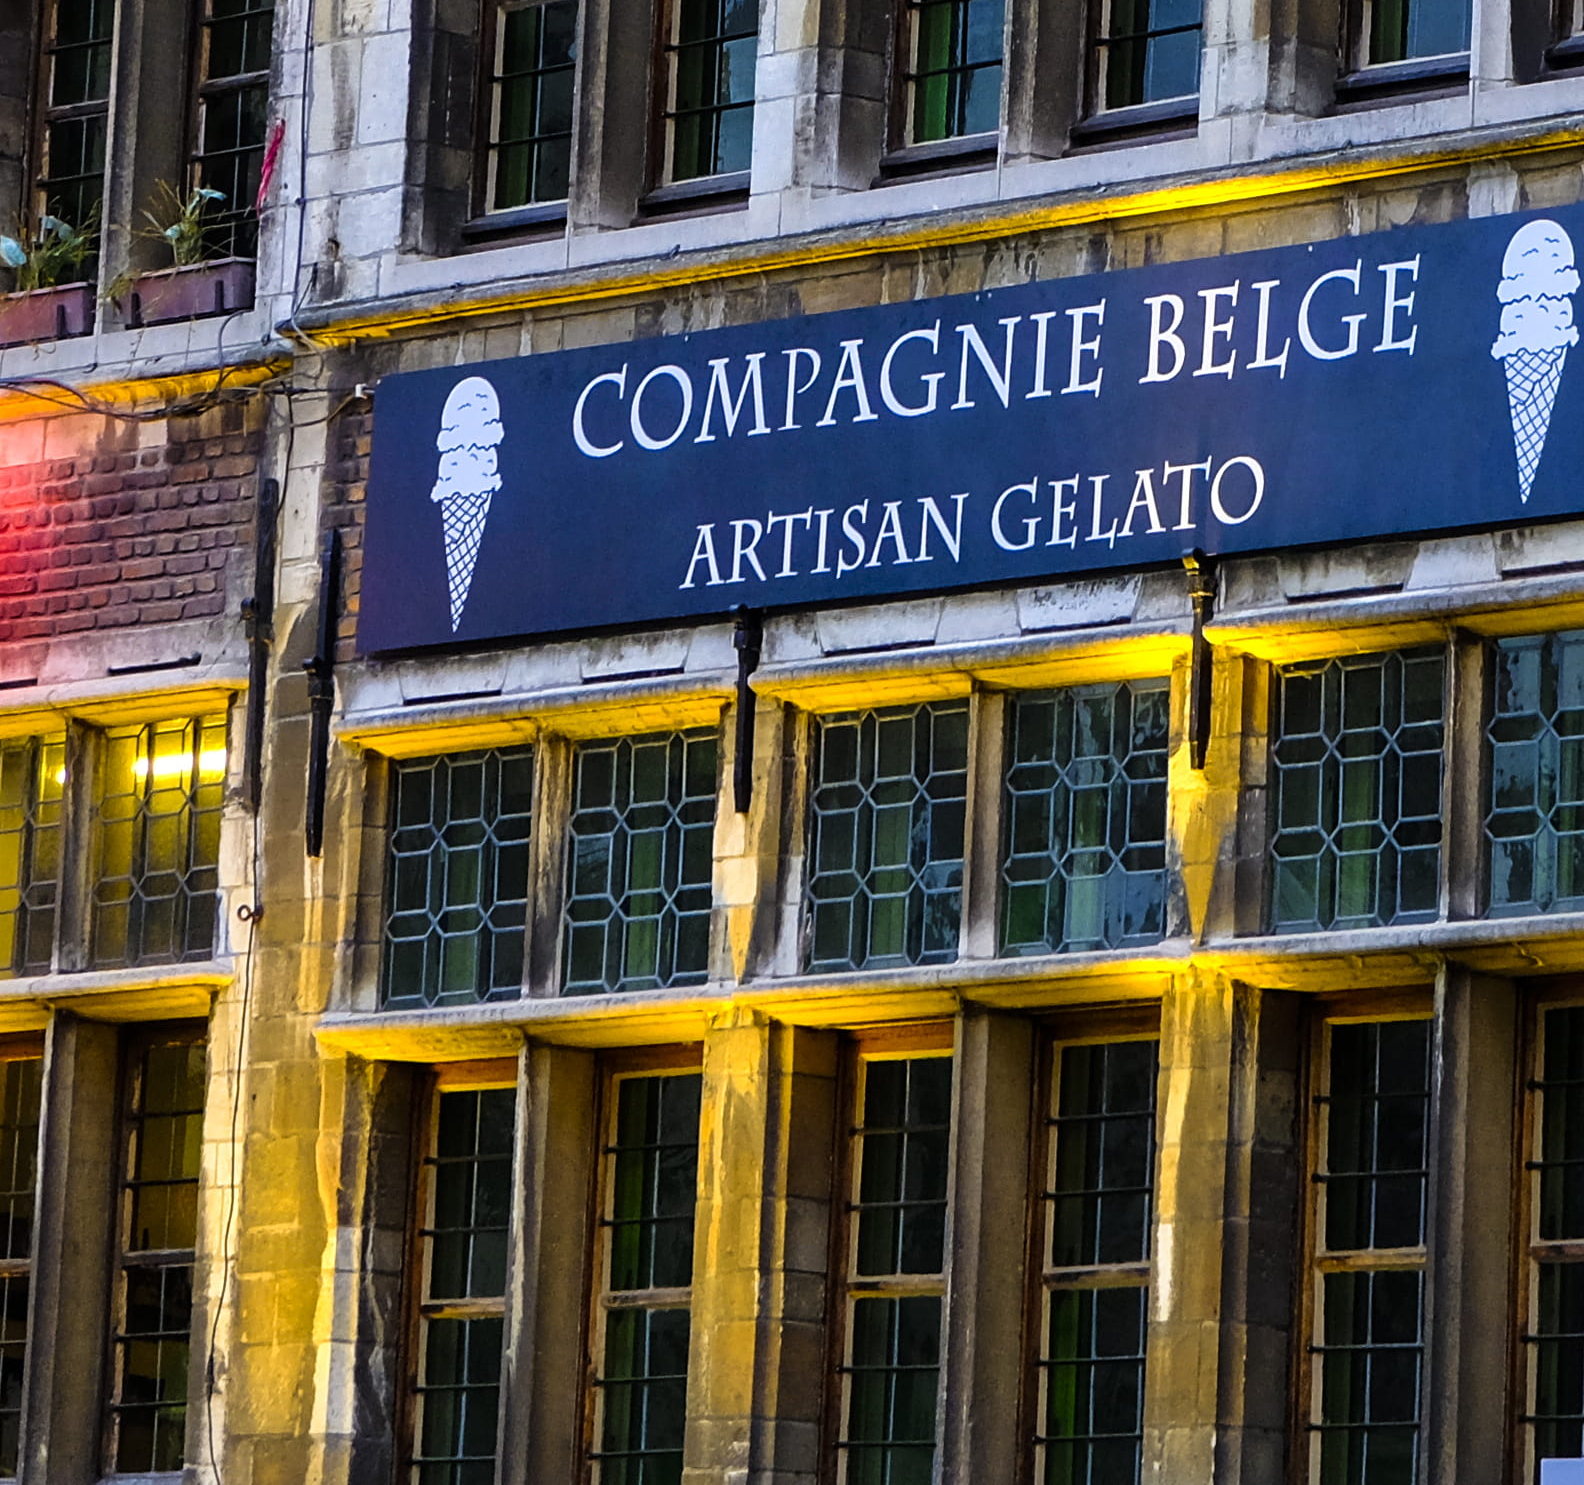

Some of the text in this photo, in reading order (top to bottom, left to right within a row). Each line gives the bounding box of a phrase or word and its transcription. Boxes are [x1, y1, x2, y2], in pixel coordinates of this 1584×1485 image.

[572, 253, 1420, 458] COMPAGNIE BELGE
[679, 455, 1265, 590] ARTISAN GELATO
